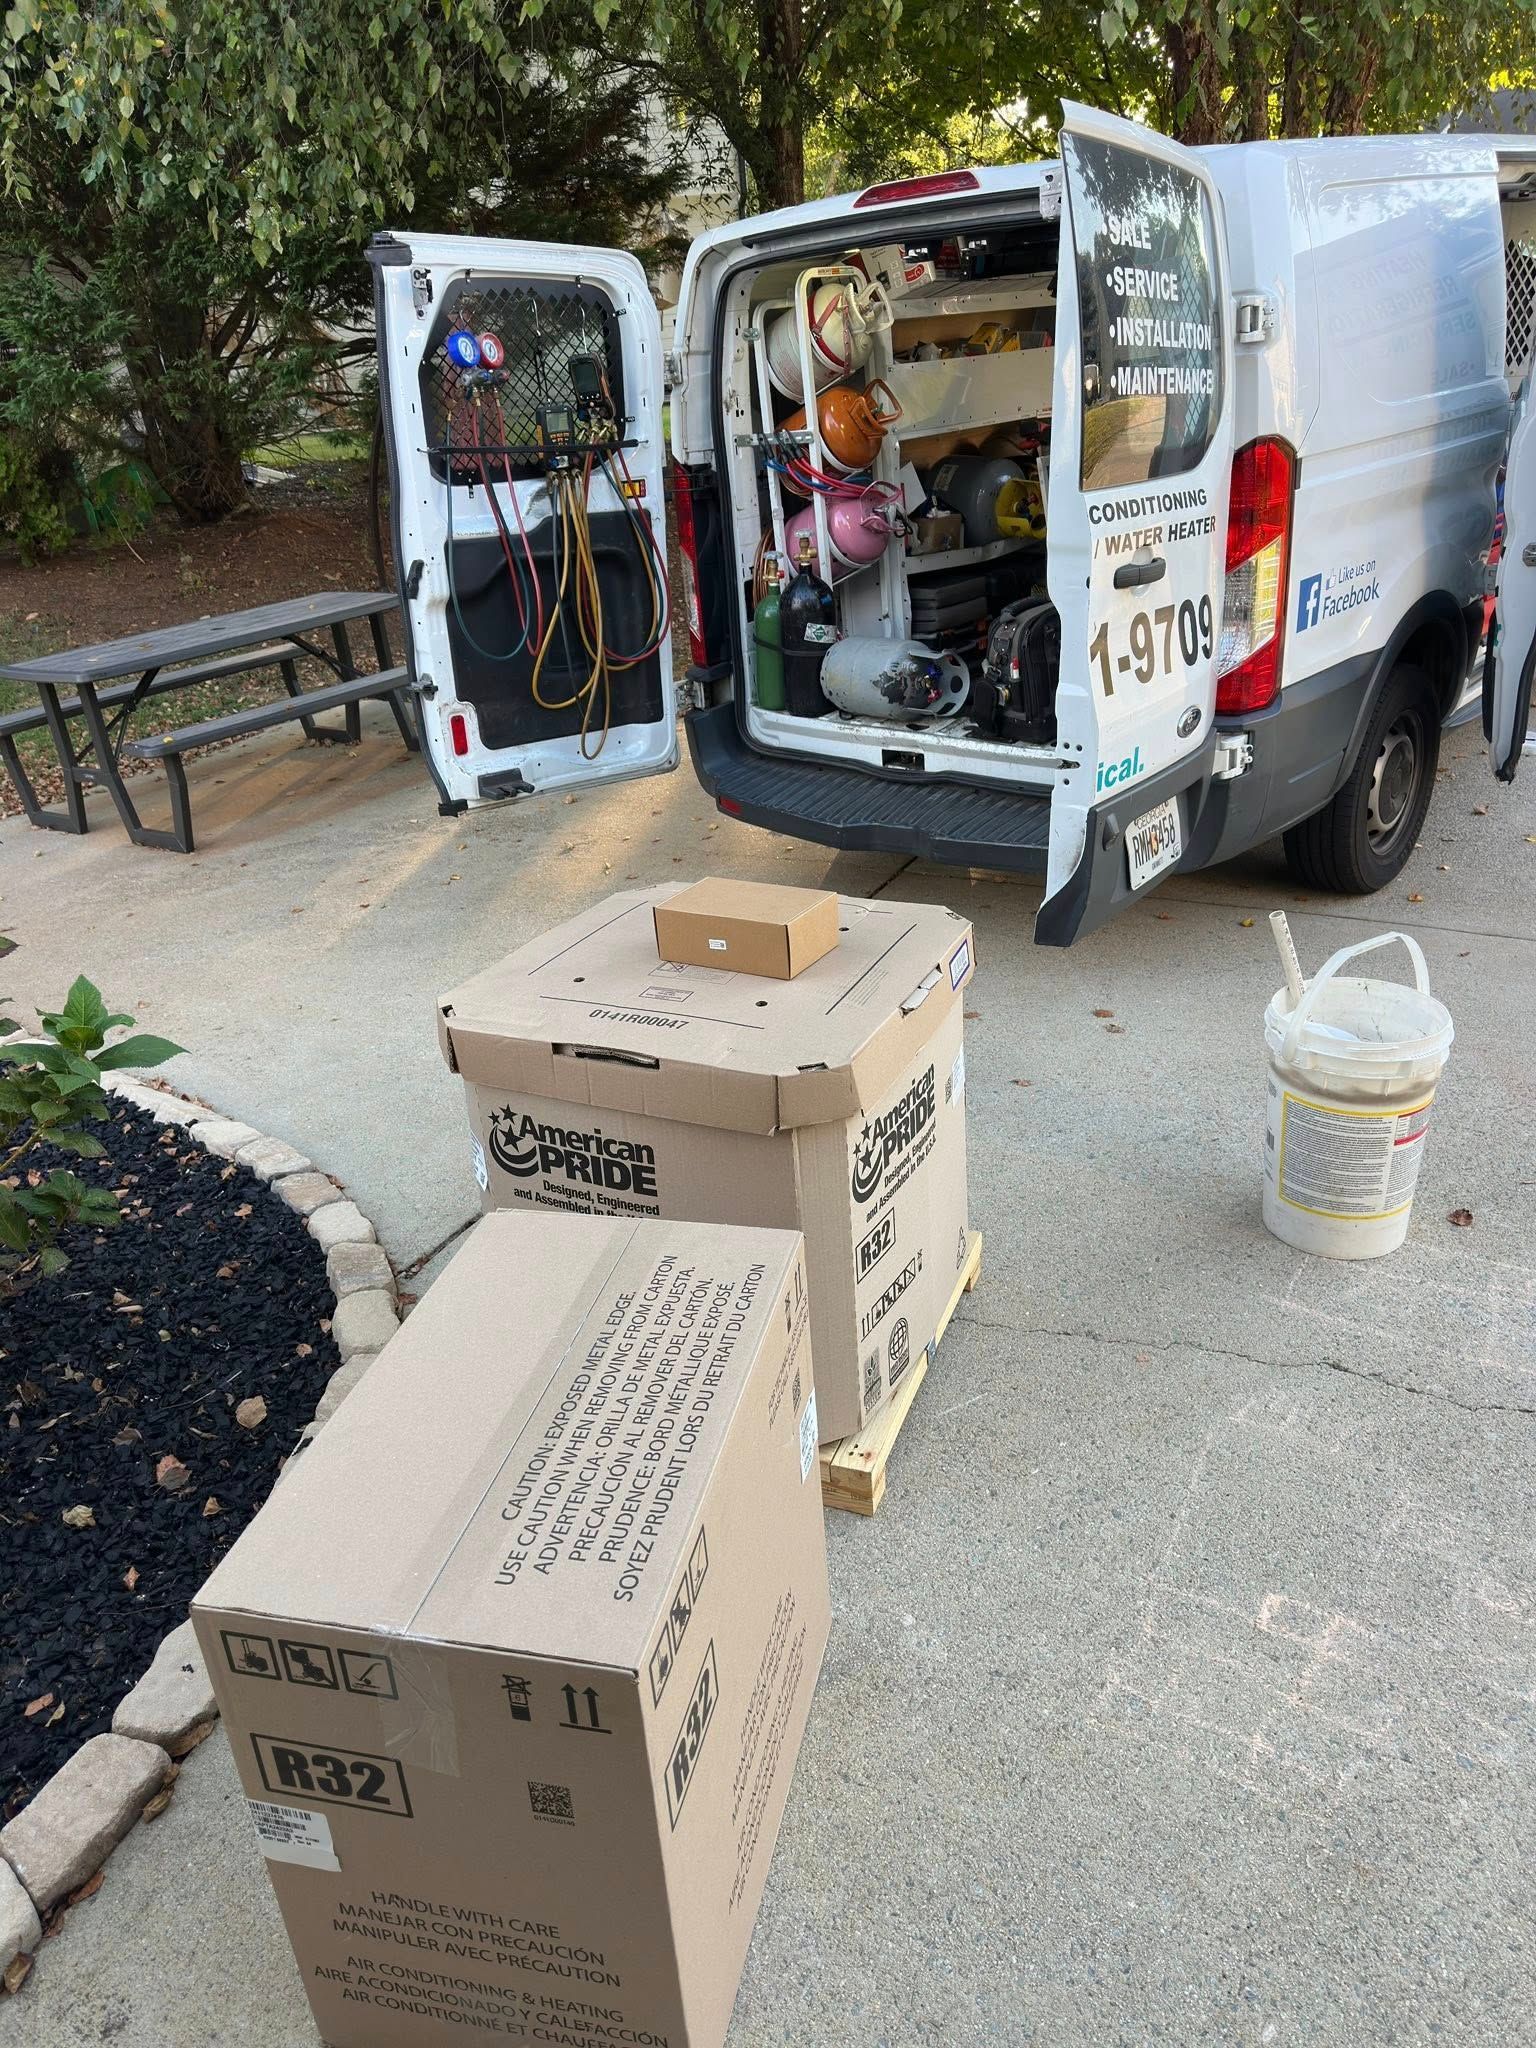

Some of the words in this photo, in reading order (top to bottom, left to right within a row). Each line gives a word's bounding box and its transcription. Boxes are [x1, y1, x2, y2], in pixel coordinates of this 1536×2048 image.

[1108, 215, 1152, 250] SALE
[1113, 266, 1179, 302] SERVICE
[1117, 317, 1212, 351] INSTALLATION
[1117, 366, 1213, 395] MAINTENANCE
[1089, 488, 1207, 525] CONDITIONING
[1105, 526, 1163, 555] WATER
[1168, 515, 1216, 542] HEATER
[1338, 565, 1355, 584] Like
[1355, 563, 1365, 577] us
[1366, 559, 1376, 573] on
[1322, 577, 1380, 620] Facebook
[1090, 594, 1213, 697] 1-9709
[589, 1009, 689, 1029] 0141R00047
[872, 1063, 934, 1148] American
[882, 1081, 936, 1170] PRIDE
[519, 1115, 655, 1165] American
[538, 1144, 658, 1197] PRIDE
[514, 1188, 533, 1201] and
[535, 1192, 592, 1215] Assembled
[543, 1180, 594, 1204] Designed,
[597, 1192, 660, 1216] Engineered
[861, 1219, 891, 1274] R32
[678, 1278, 714, 1328] CARTÓN.
[735, 1263, 765, 1310] CARTON
[664, 1331, 689, 1355] DEL
[725, 1313, 746, 1332] DU
[702, 1333, 736, 1386] RETRAIT
[501, 1443, 556, 1520] CAUTION:
[544, 1374, 591, 1439] EXPOSED
[581, 1329, 617, 1371] METAL
[605, 1291, 636, 1326] EDGE.
[632, 1358, 676, 1425] REMOVER
[691, 1389, 714, 1411] DU
[494, 1550, 528, 1585] USE
[517, 1469, 569, 1546] CAUTION
[557, 1419, 595, 1466] WHEN
[584, 1343, 633, 1415] REMOVING
[622, 1304, 653, 1339] FROM
[643, 1255, 678, 1301] CARTON
[533, 1452, 606, 1574] ADVERTENCIA:
[595, 1396, 633, 1448] ORILLA
[621, 1373, 643, 1393] DE
[632, 1329, 666, 1371] METAL
[654, 1266, 695, 1326] EXPUESTA.
[598, 1466, 656, 1562] PRUDENCE:
[643, 1418, 675, 1461] BORD
[664, 1331, 713, 1414] MÉTALLIQUE
[701, 1282, 735, 1328] EXPOSÉ.
[622, 1429, 645, 1448] AL
[674, 1415, 704, 1453] LORS
[568, 1452, 633, 1562] PRECAUCIÓN
[640, 1455, 687, 1536] PRUDENT
[613, 1540, 654, 1602] SOYEZ
[672, 1667, 711, 1801] R32
[272, 1745, 392, 1805] R32
[339, 1902, 428, 1931] MANEJAR
[431, 1922, 474, 1941] CON
[479, 1931, 605, 1966] PRECAUCIÓN
[371, 1891, 450, 1918] HANDLE
[452, 1907, 503, 1928] WITH
[508, 1918, 561, 1939] CARE
[333, 1919, 440, 1951] MANIPULER
[445, 1943, 493, 1962] AVEC
[497, 1952, 621, 1987] PRÉCAUTION
[314, 1965, 353, 1984] AIRE
[357, 1975, 516, 2018] ACONDICIONADO
[519, 2008, 530, 2020] Y
[536, 2012, 668, 2048] CALEFACCIÓN
[343, 1988, 372, 2004] AIR
[375, 1995, 502, 2032] CONDITIONNÉ
[506, 2022, 529, 2036] ET
[347, 1956, 376, 1971] AIR
[379, 1963, 517, 2001] CONDITIONING
[522, 1992, 535, 2005] &
[540, 1995, 624, 2023] HEATING
